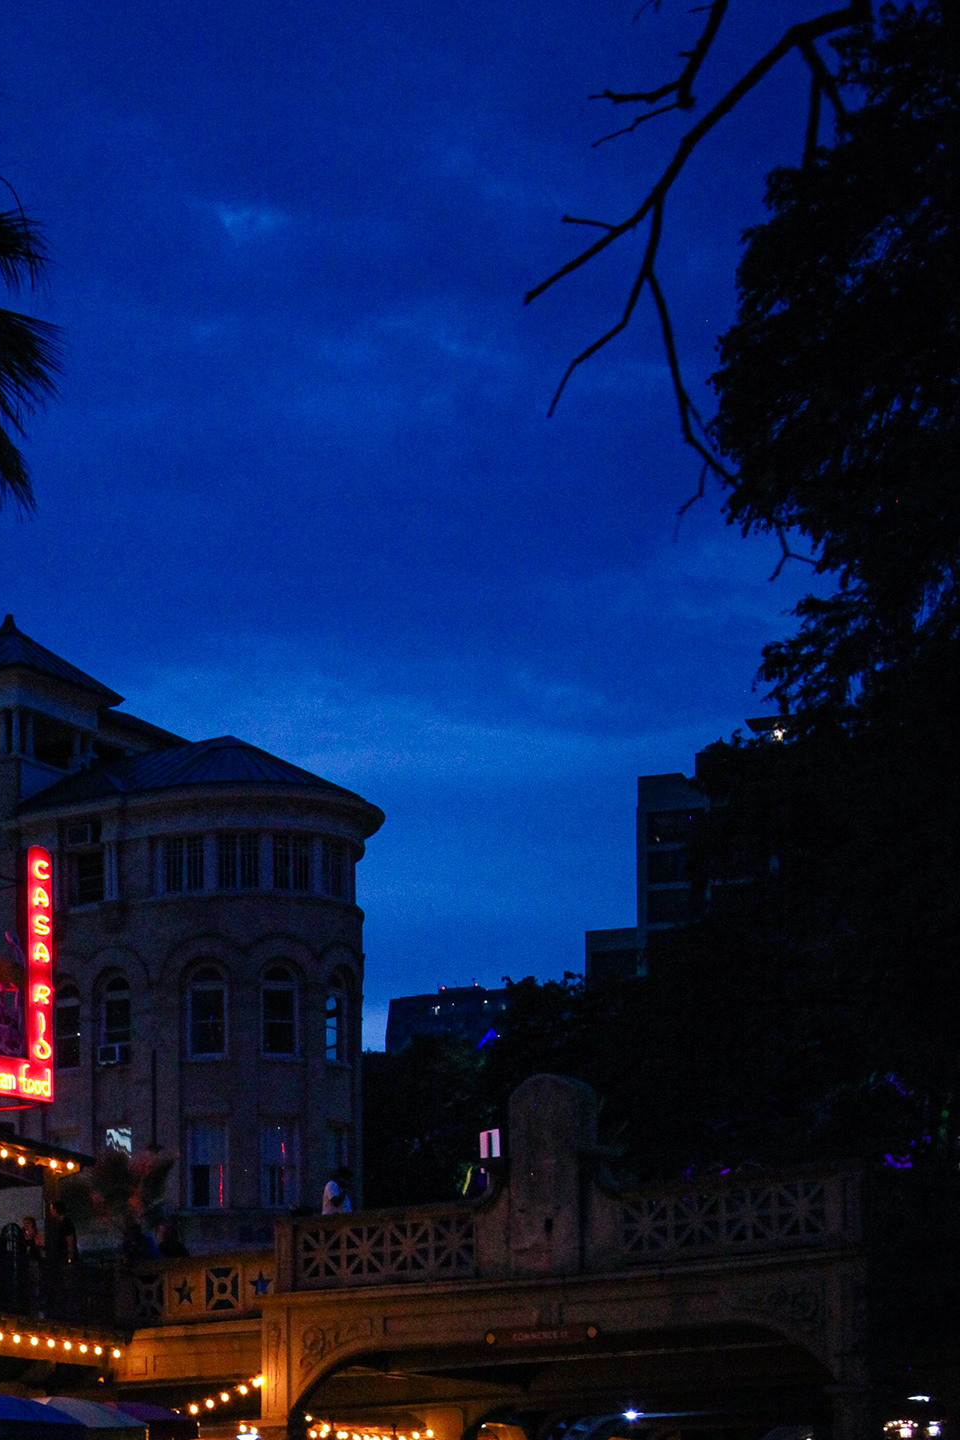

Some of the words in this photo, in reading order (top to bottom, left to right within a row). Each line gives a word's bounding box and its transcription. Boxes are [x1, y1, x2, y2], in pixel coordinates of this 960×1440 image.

[33, 860, 50, 962] CASA
[33, 985, 51, 1060] RIO
[19, 1063, 51, 1097] food
